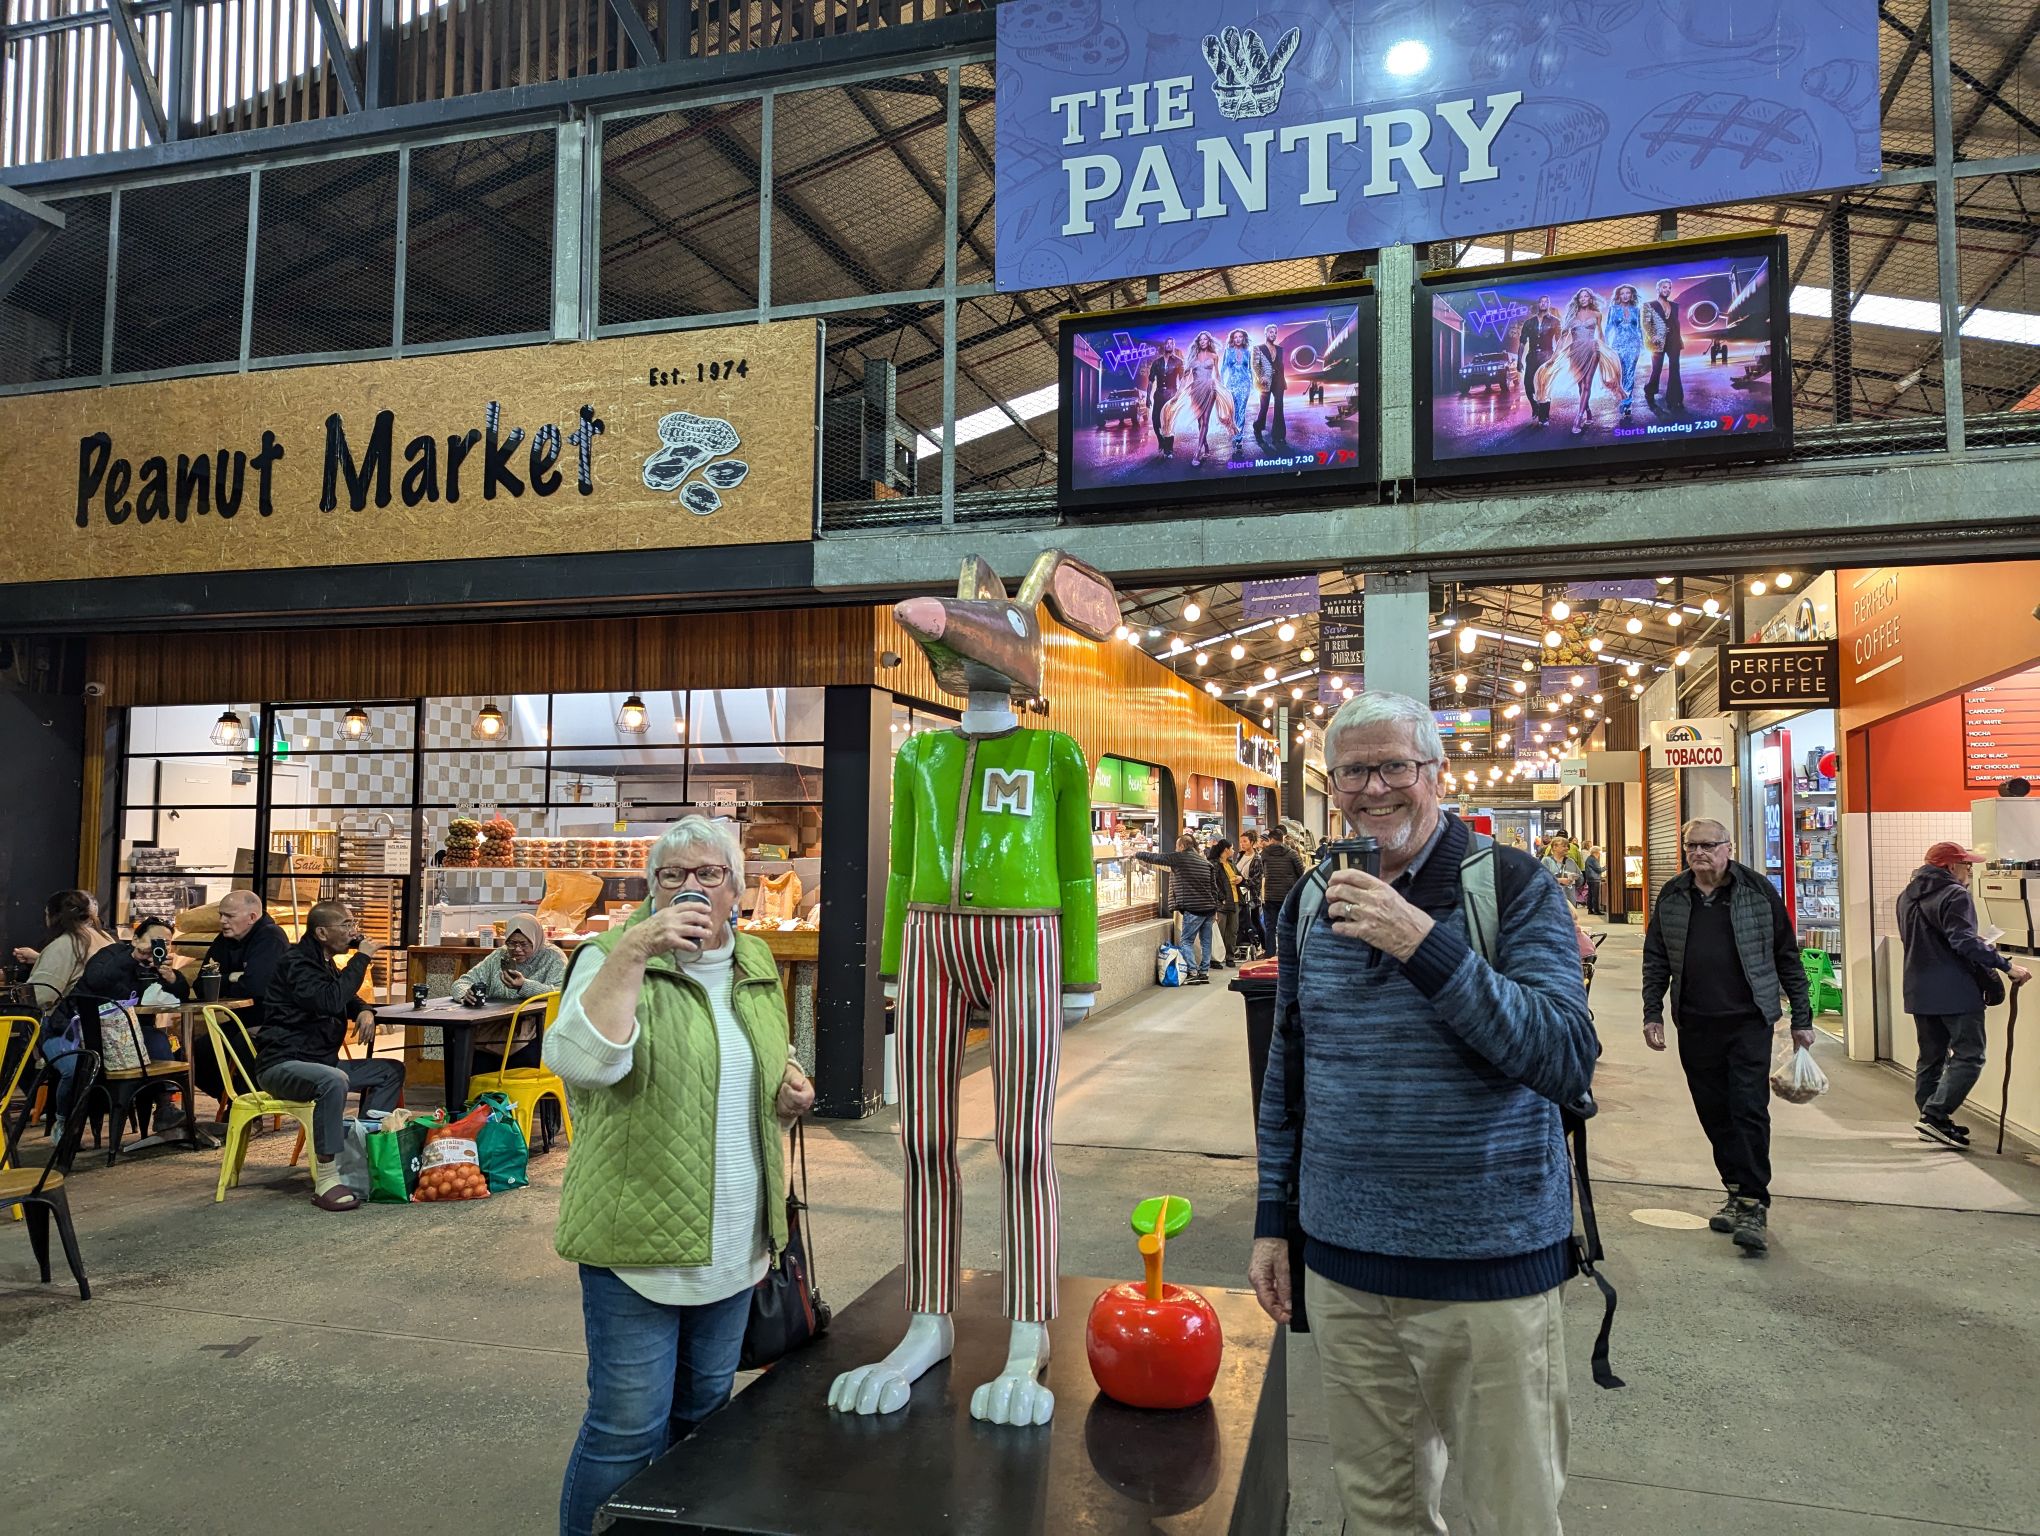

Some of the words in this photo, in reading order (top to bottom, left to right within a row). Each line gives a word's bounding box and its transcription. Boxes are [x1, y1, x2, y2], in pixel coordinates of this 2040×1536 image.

[1051, 75, 1194, 146] THE
[1061, 90, 1523, 237] PANTRY
[648, 366, 687, 387] Est.
[696, 358, 750, 381] 1974
[1614, 427, 1645, 437] Starts
[1647, 422, 1693, 434] Monday
[1695, 420, 1718, 430] 7.30
[75, 430, 284, 528] Peanut
[319, 401, 606, 513] Market
[1227, 460, 1254, 470] Starts
[1255, 457, 1293, 467] Monday
[1295, 455, 1314, 465] 7.30
[1854, 572, 1900, 626] PERFECT
[1327, 605, 1363, 615] MARKET
[1323, 625, 1348, 635] Save
[1855, 615, 1901, 665] COFFEE
[1730, 656, 1825, 674] PERFECT
[1730, 677, 1827, 695] COFFEE
[1665, 747, 1723, 766] TOBACCO
[984, 769, 1032, 814] M
[293, 858, 322, 871] Satin
